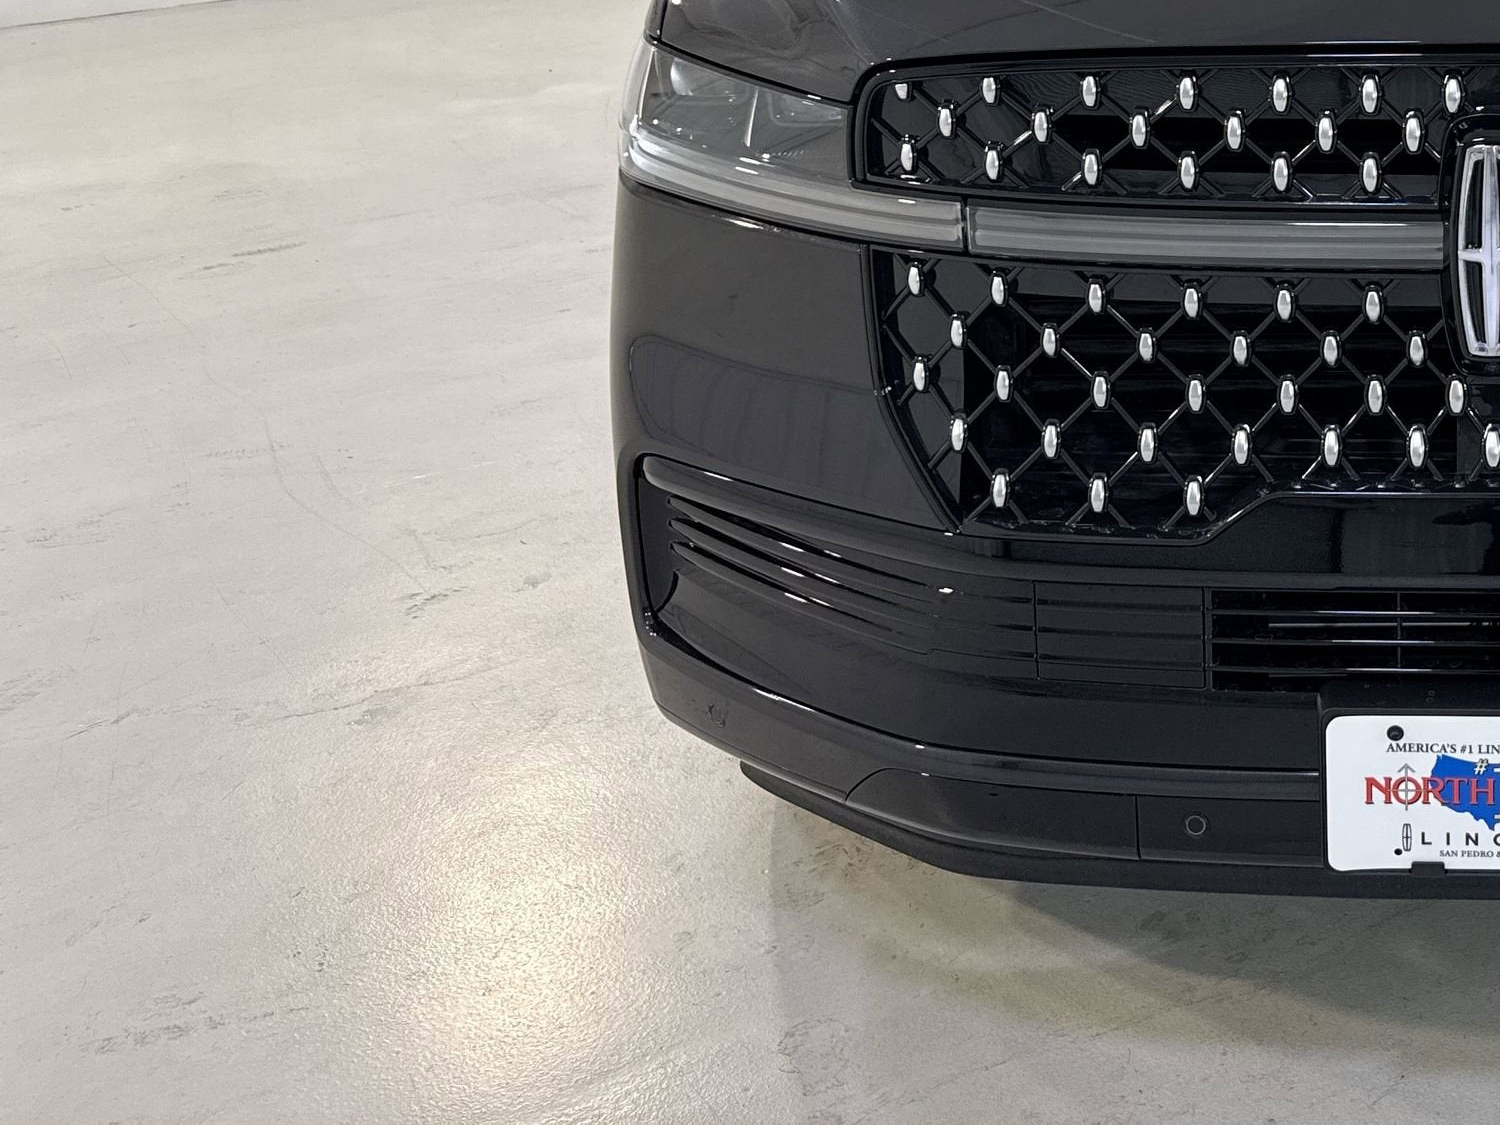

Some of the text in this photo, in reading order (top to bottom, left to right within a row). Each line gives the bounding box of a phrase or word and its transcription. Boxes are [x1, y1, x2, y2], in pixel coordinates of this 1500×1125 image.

[1386, 742, 1457, 755] AMERICA'S
[1460, 744, 1475, 755] #1
[1365, 776, 1495, 807] NORTH
[1439, 849, 1459, 858] SAN
[1461, 849, 1494, 859] PEDRO
